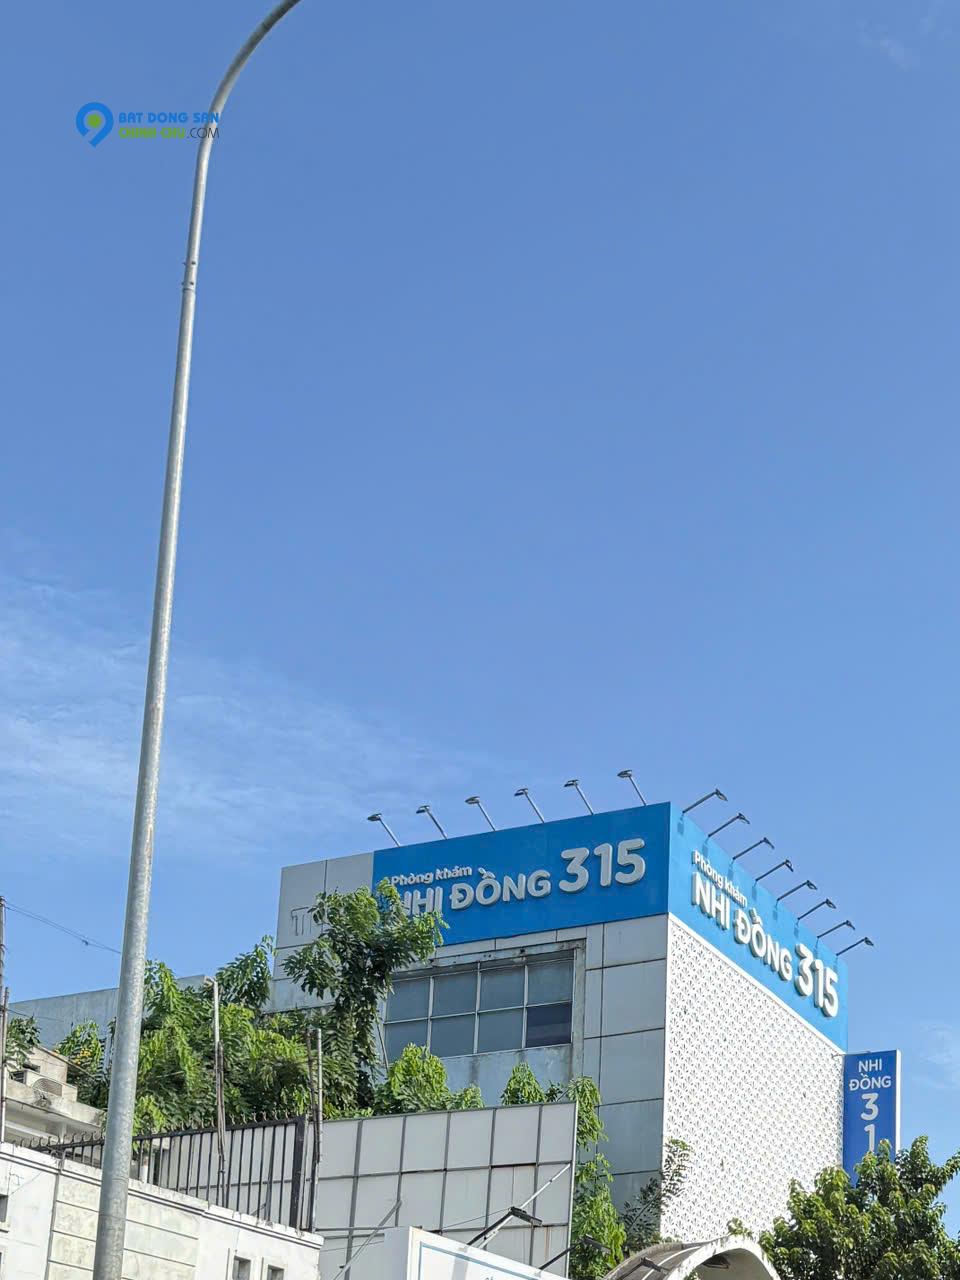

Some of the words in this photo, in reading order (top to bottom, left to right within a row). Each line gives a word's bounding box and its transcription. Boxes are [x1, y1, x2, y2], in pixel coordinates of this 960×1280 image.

[435, 865, 472, 880] khám
[449, 867, 551, 911] ĐỒNG
[558, 838, 646, 893] 315
[691, 871, 731, 931] NHI
[733, 907, 793, 982] ĐỒNG
[794, 942, 839, 1019] 315
[858, 1059, 883, 1073] NHI
[849, 1073, 892, 1091] ĐỒNG
